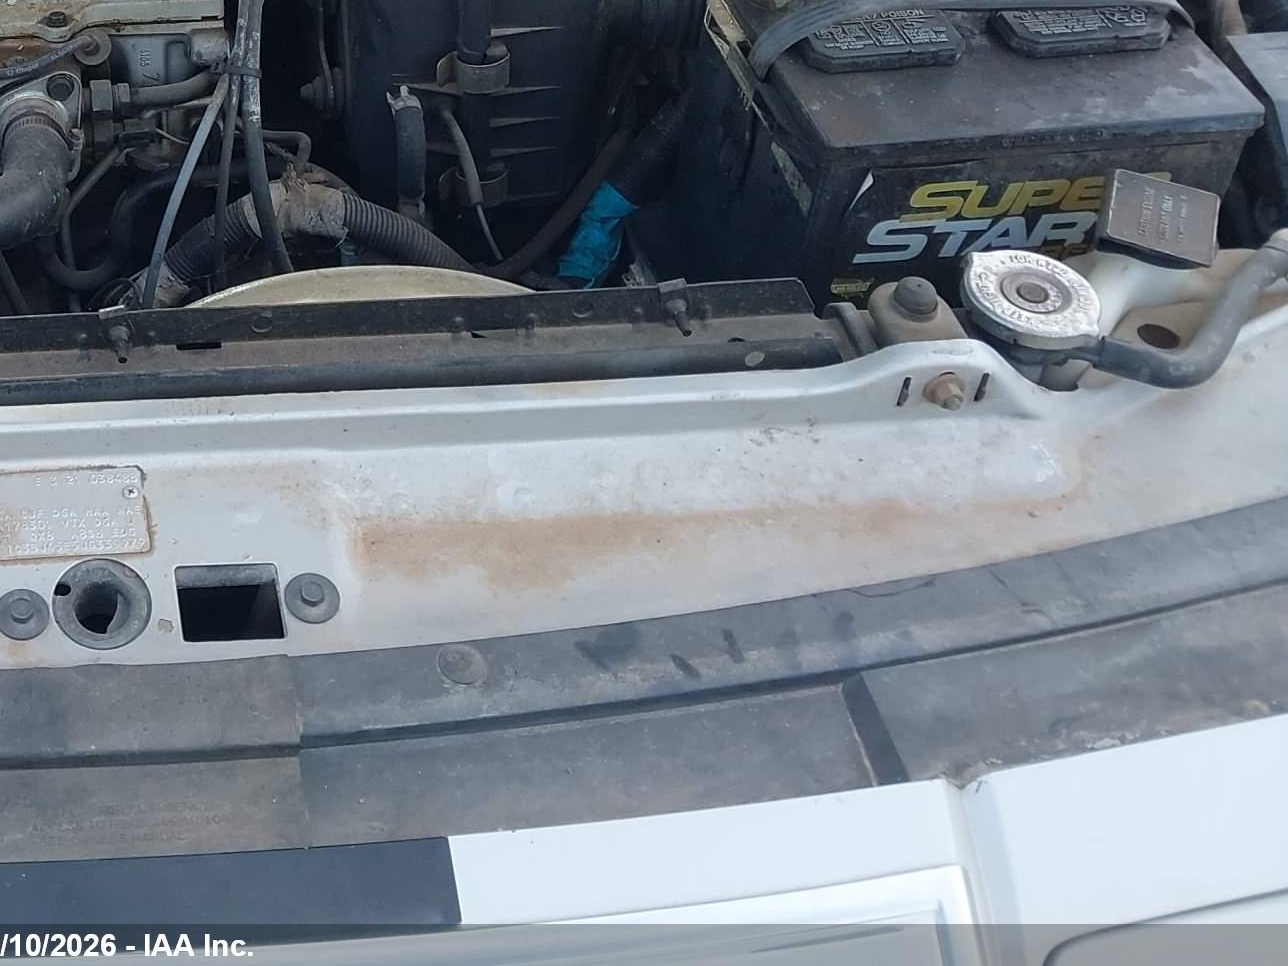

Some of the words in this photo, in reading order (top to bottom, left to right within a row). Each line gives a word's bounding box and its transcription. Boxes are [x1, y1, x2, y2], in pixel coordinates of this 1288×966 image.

[880, 9, 925, 20] POISON
[899, 172, 1172, 223] SUPE
[852, 212, 1100, 265] STAR
